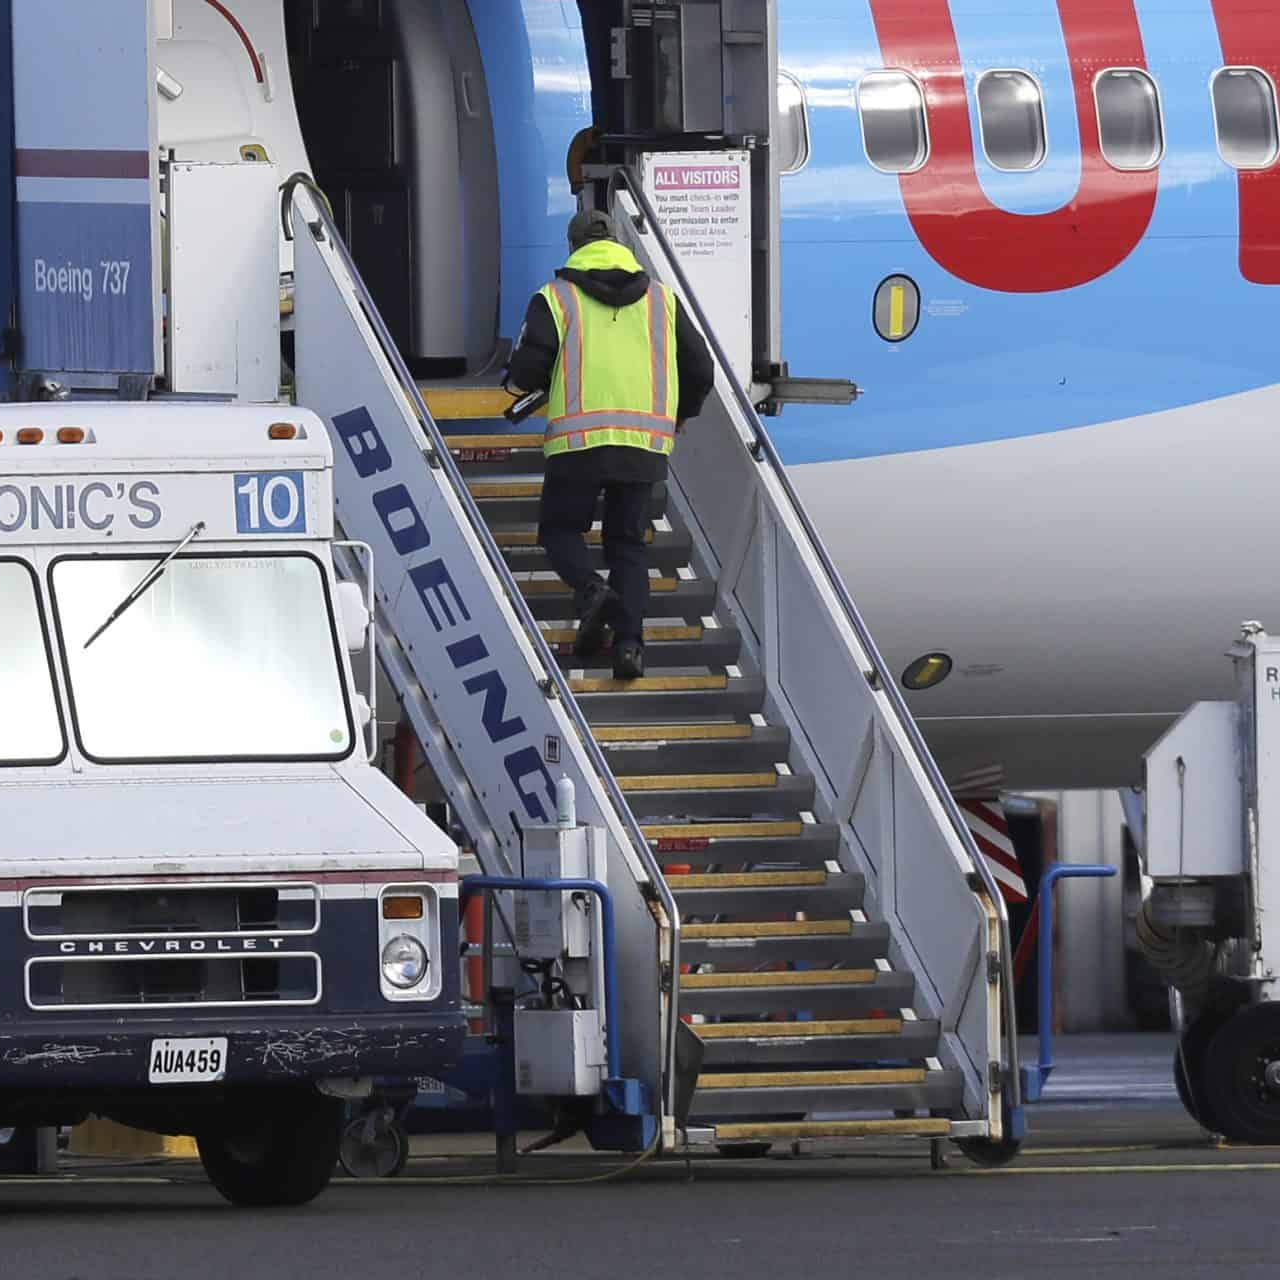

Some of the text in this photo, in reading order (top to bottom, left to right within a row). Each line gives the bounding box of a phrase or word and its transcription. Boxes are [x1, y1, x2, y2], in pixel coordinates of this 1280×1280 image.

[656, 170, 738, 185] ALL VISITORS
[690, 193, 721, 201] check-in
[723, 193, 739, 201] with
[658, 205, 736, 214] Airplane Team Leader
[669, 217, 710, 225] permission
[711, 217, 719, 225] to
[720, 216, 738, 224] enter
[35, 259, 131, 301] Boeing 737
[238, 475, 300, 529] 10
[331, 406, 559, 824] BOEING
[60, 938, 284, 953] CHEVROLET
[152, 1049, 222, 1074] AUA459
